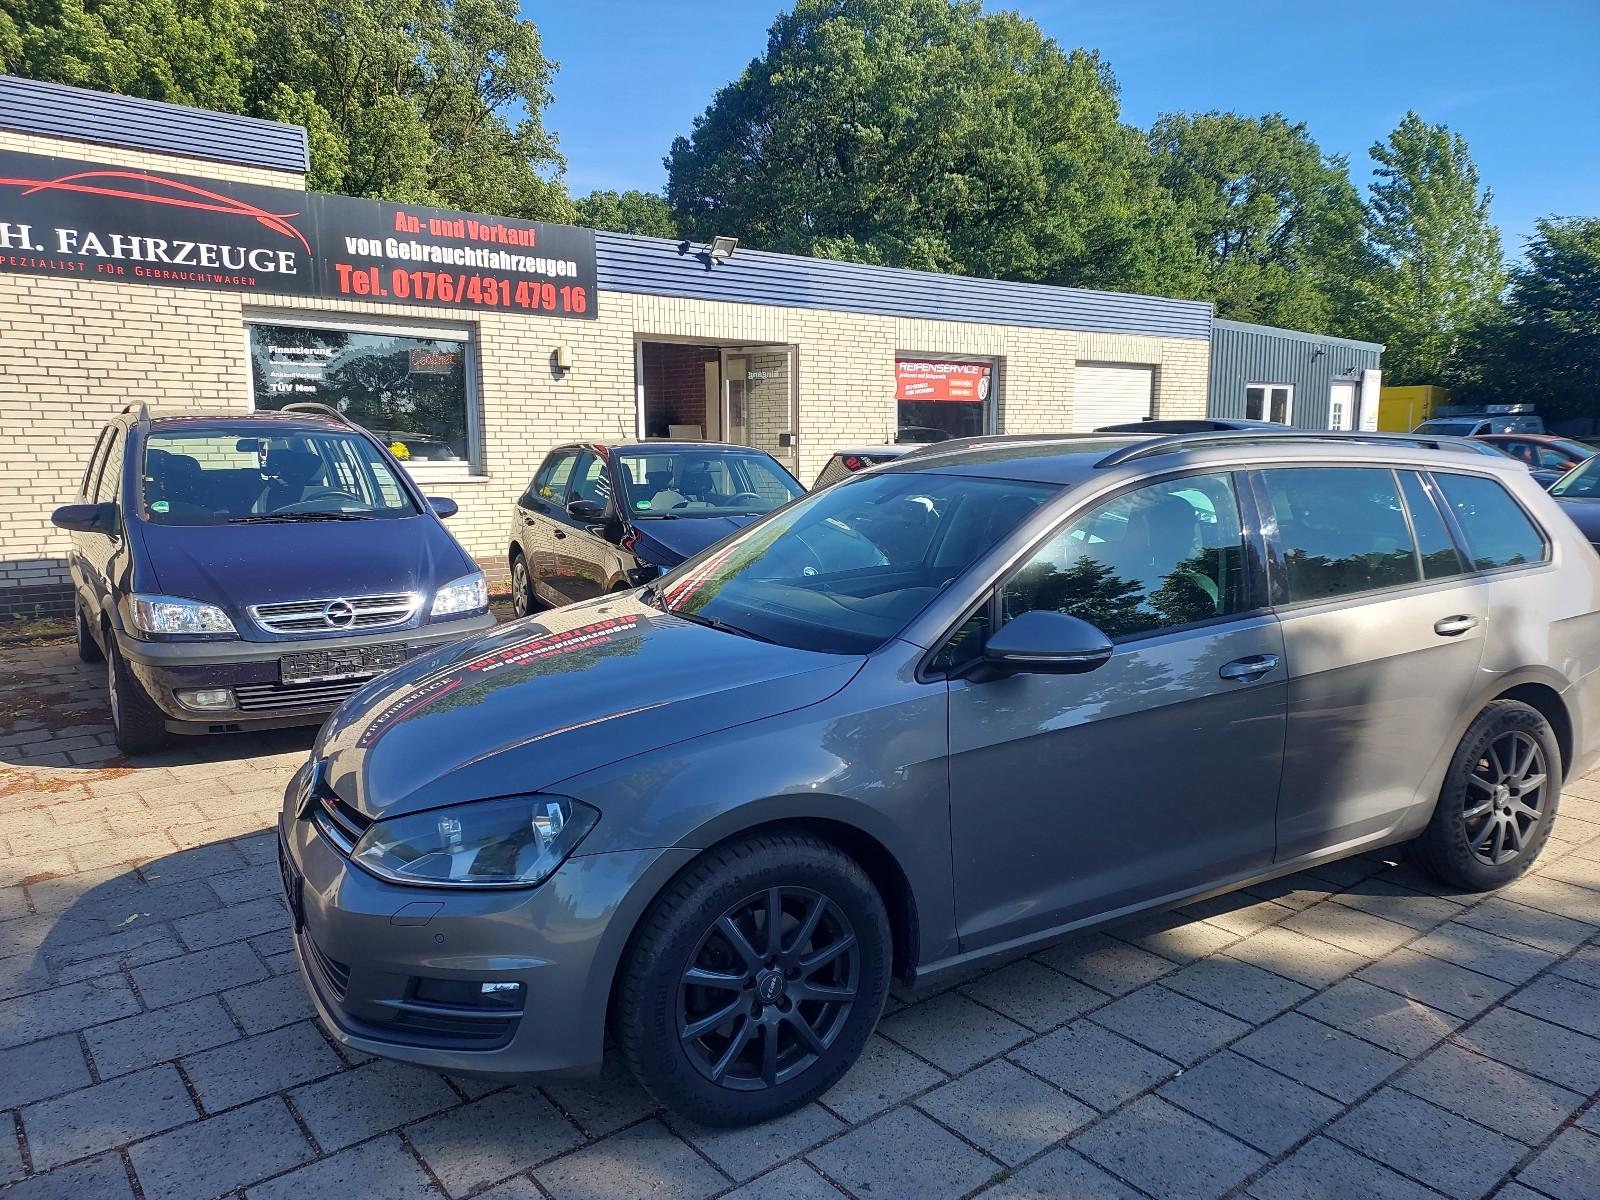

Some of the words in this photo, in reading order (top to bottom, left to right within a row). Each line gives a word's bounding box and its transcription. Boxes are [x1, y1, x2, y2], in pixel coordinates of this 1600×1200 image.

[395, 211, 427, 233] An-
[429, 218, 465, 239] und
[468, 220, 536, 249] Verkauf
[0, 223, 44, 252] H.
[54, 228, 298, 275] FAHRZEUGE
[345, 236, 387, 258] von
[385, 237, 578, 279] Gebrauchtfahrzeugen
[97, 263, 125, 276] FÜR
[135, 266, 257, 287] GEBRAUCHTWAGEN
[335, 263, 389, 297] Tel.
[392, 268, 511, 307] 0176/431
[514, 280, 556, 311] 479
[560, 285, 587, 314] 16
[267, 345, 333, 357] Finanzierung
[898, 361, 980, 375] REIFENSERVICE
[269, 382, 293, 392] TÜV
[295, 384, 317, 393] Neu
